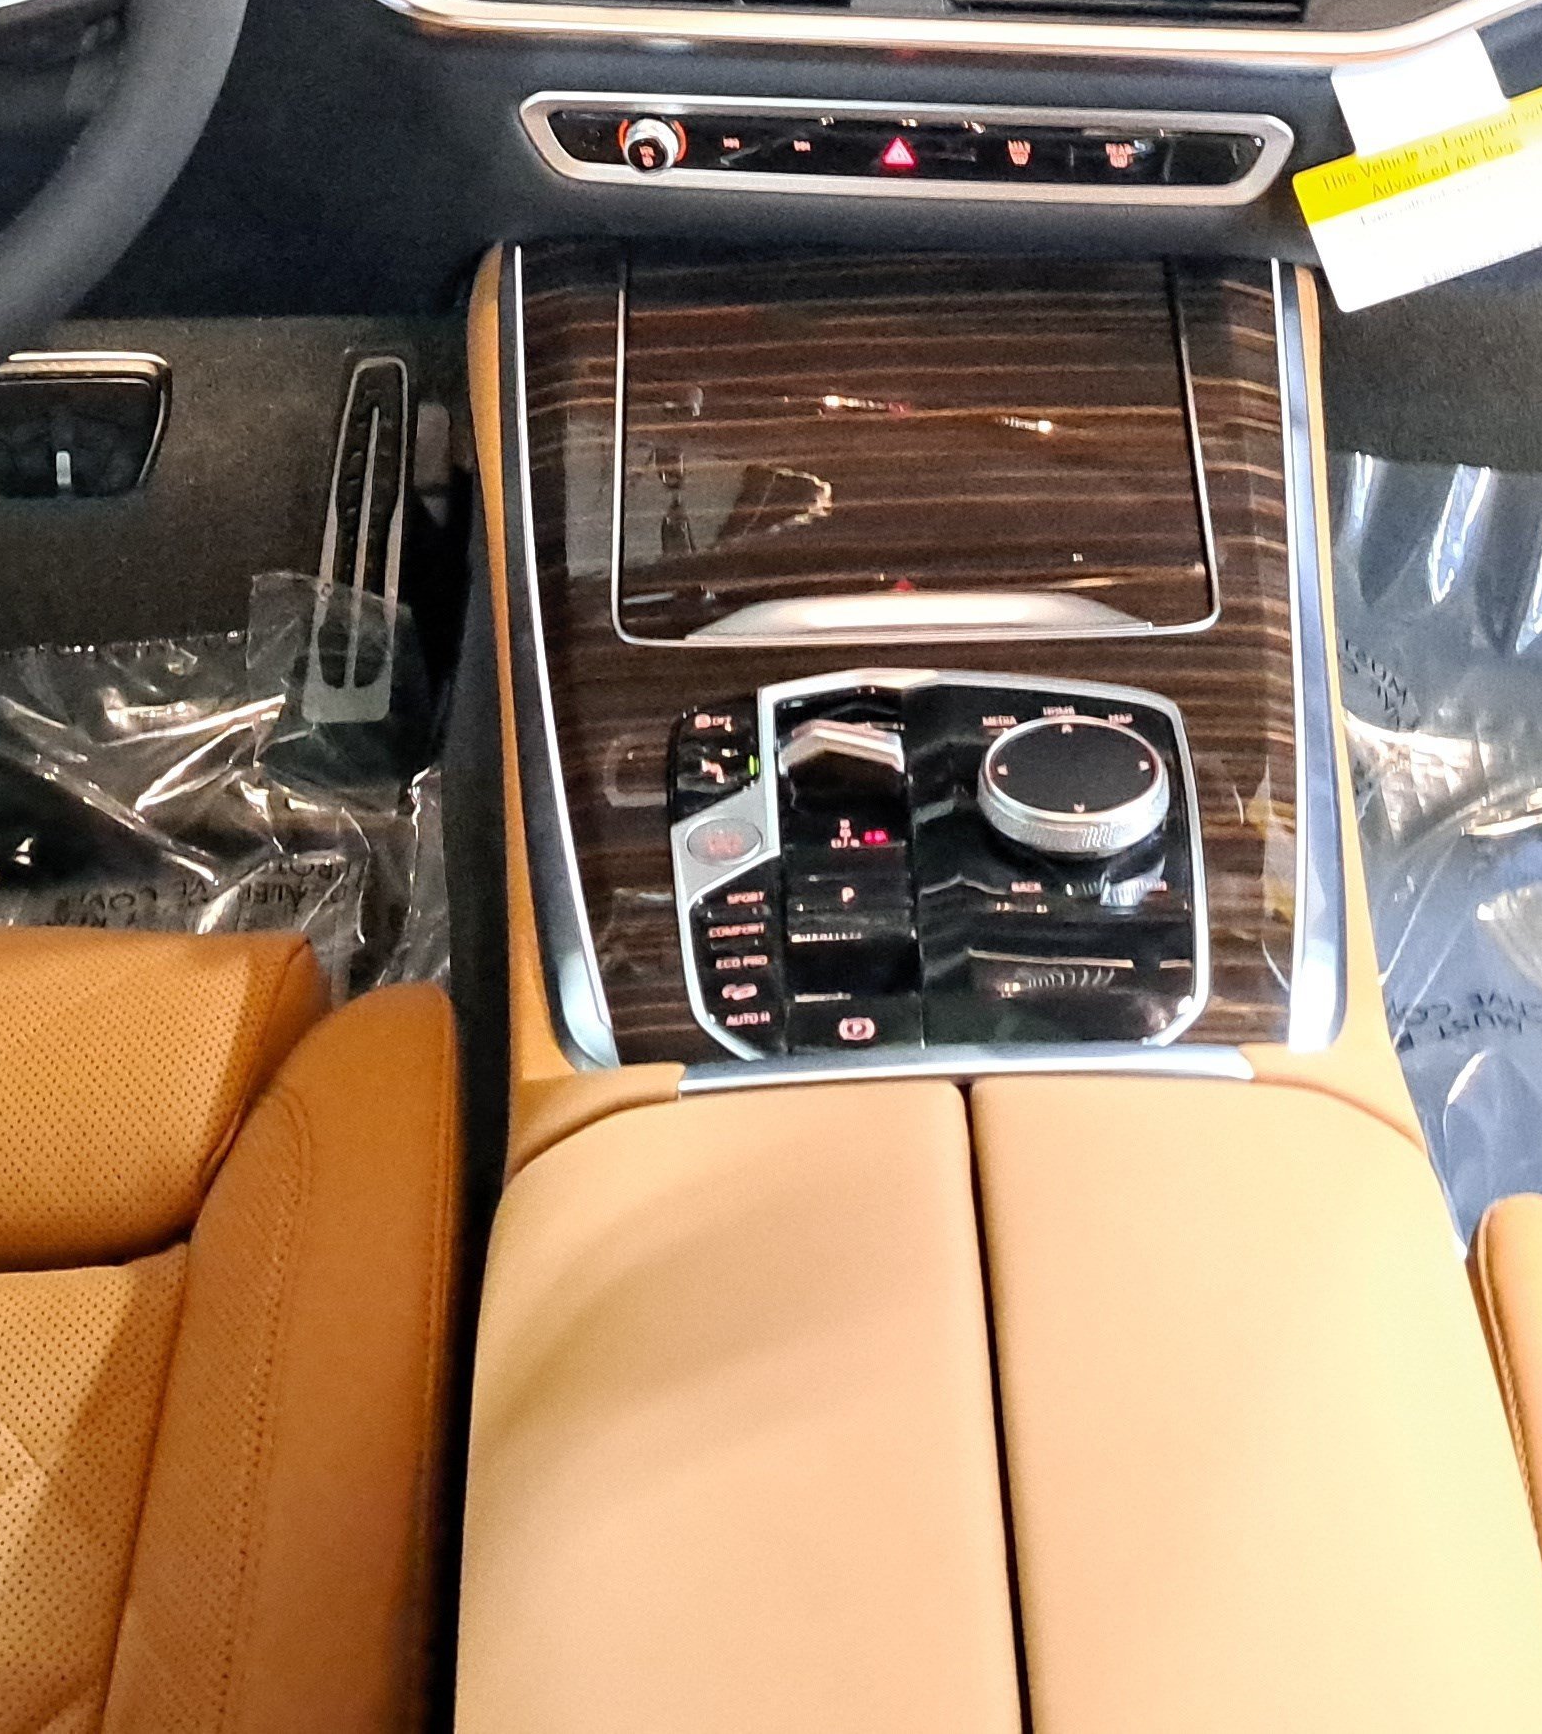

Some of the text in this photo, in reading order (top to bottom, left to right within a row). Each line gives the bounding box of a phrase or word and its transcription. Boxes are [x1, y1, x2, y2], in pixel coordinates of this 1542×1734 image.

[1321, 172, 1357, 194] This
[1358, 148, 1420, 178] Vehicle
[1371, 159, 1452, 200] Advanced
[841, 886, 856, 904] P
